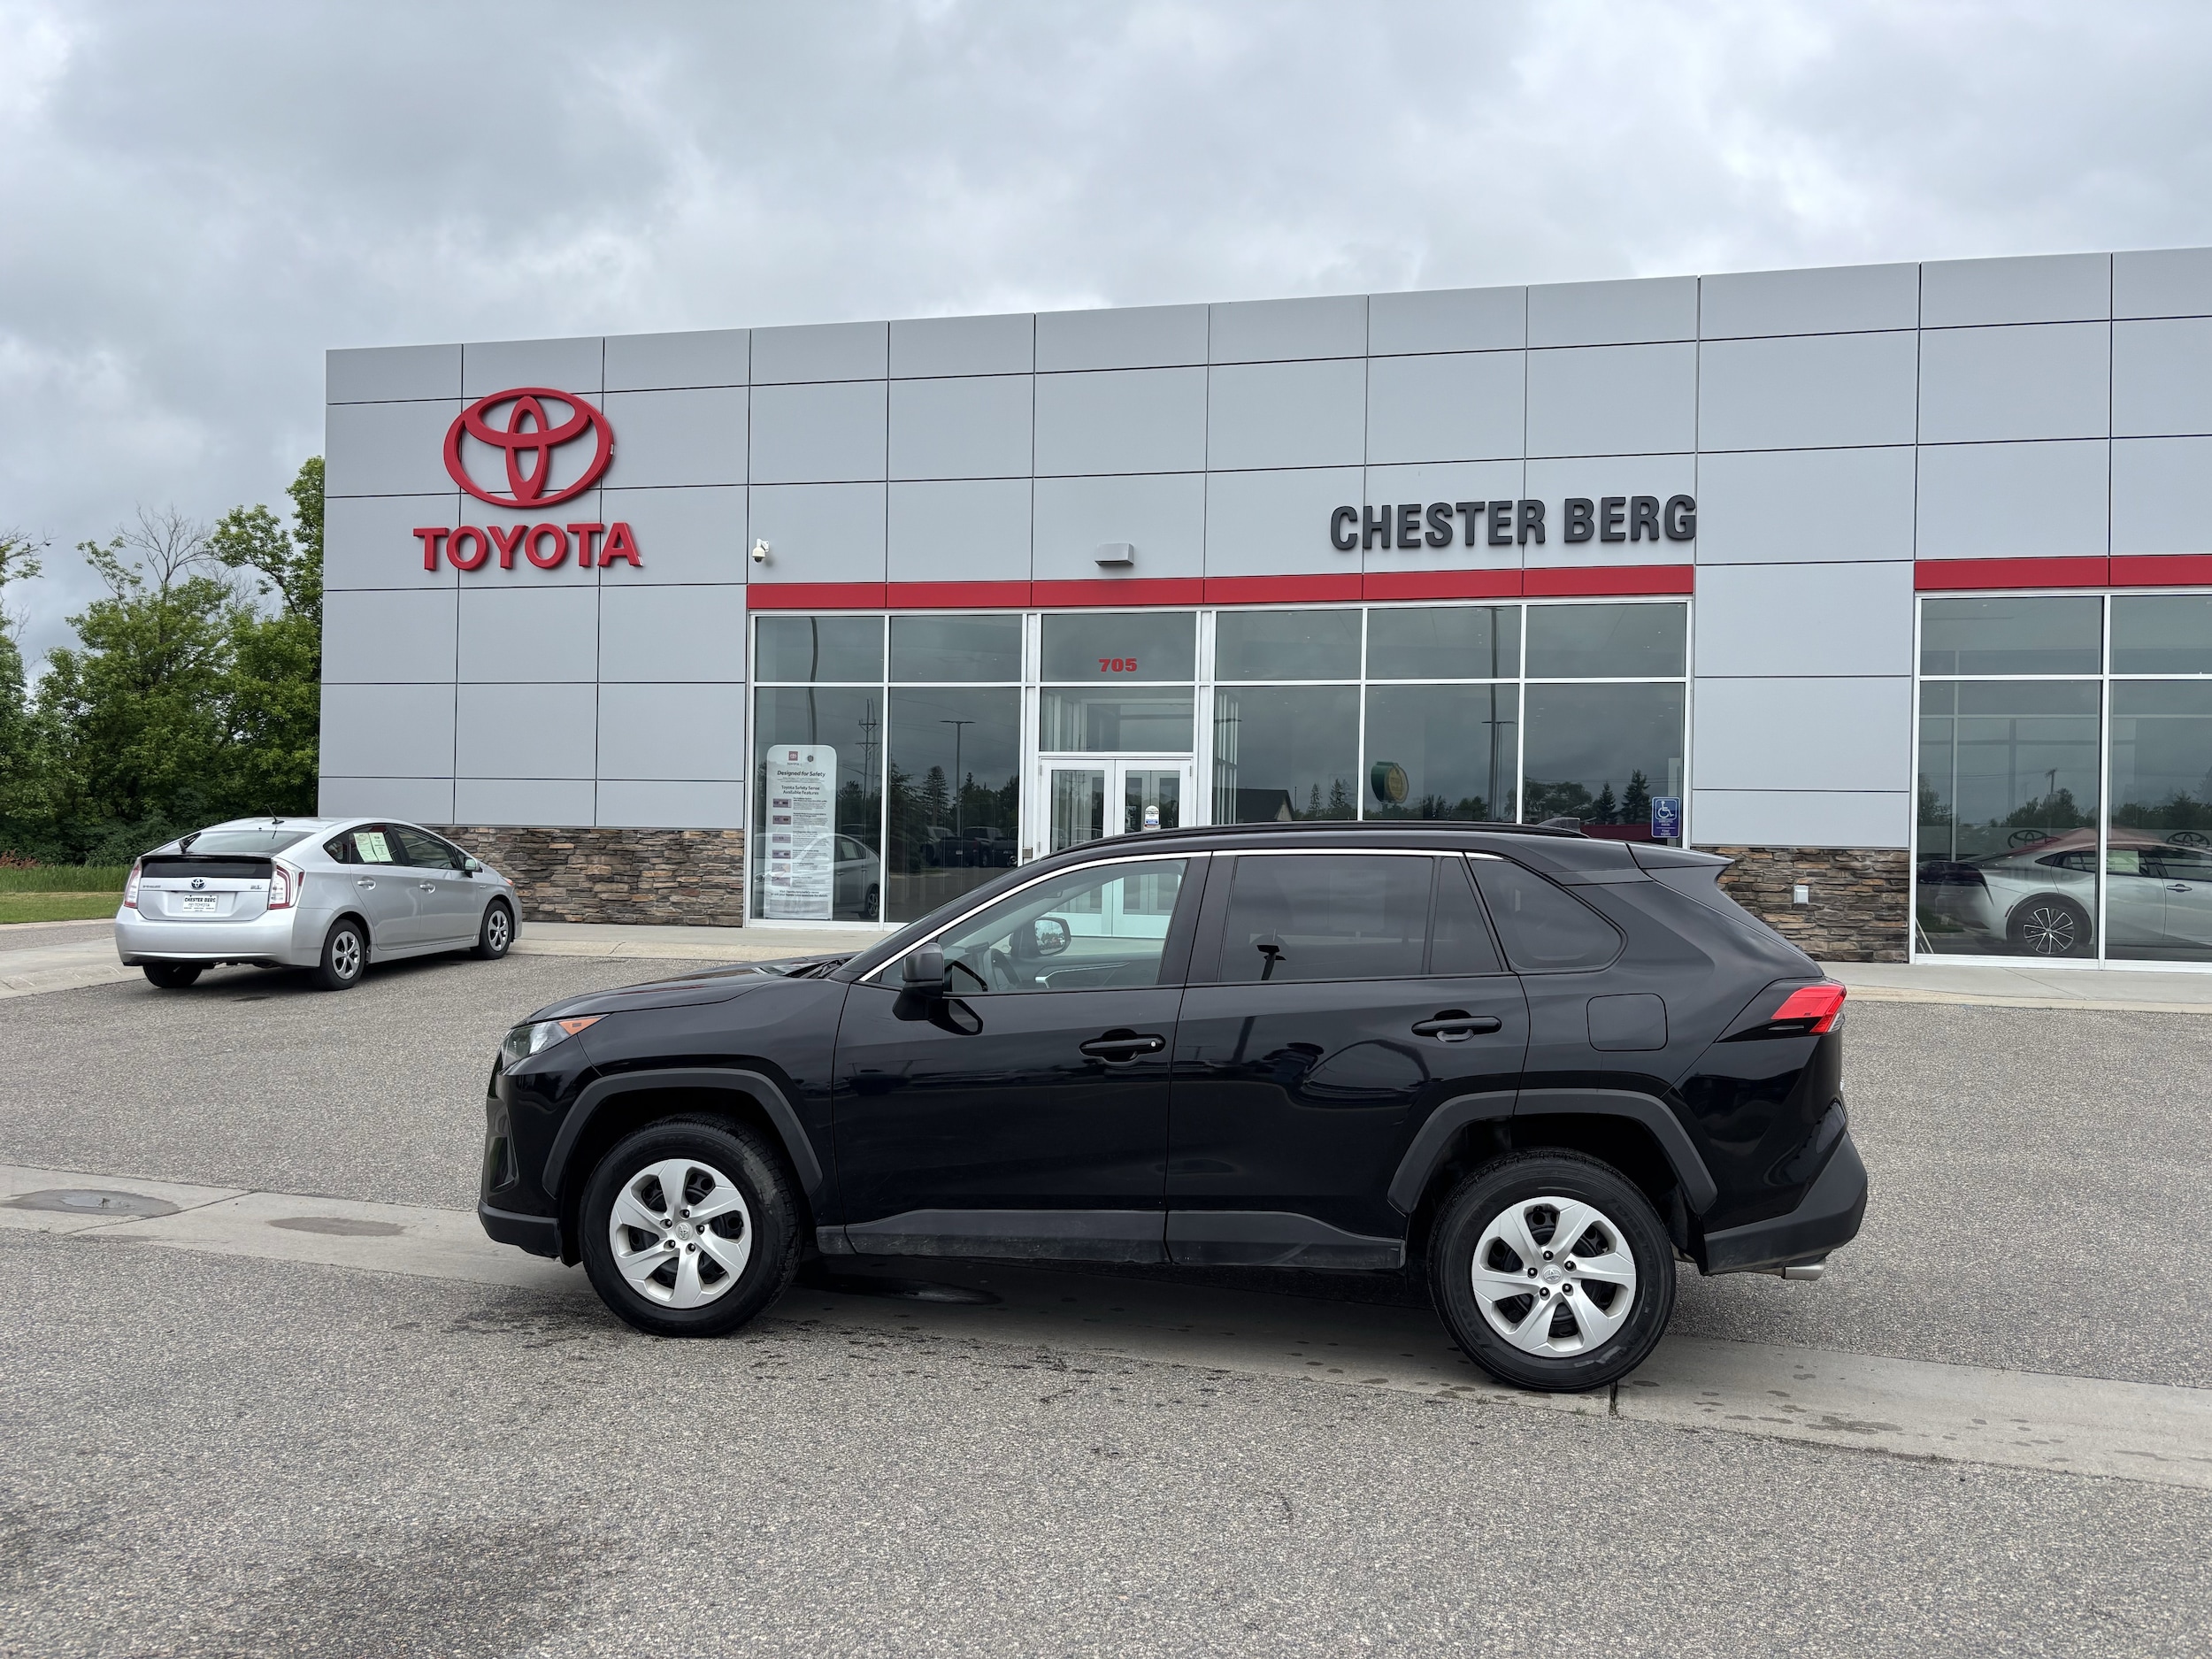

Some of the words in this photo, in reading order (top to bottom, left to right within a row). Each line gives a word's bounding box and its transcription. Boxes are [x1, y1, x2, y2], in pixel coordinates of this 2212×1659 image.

[412, 522, 644, 571] TOYOTA
[1330, 498, 1546, 550] CHESTER
[1563, 494, 1696, 543] BERG
[1098, 657, 1138, 672] 705
